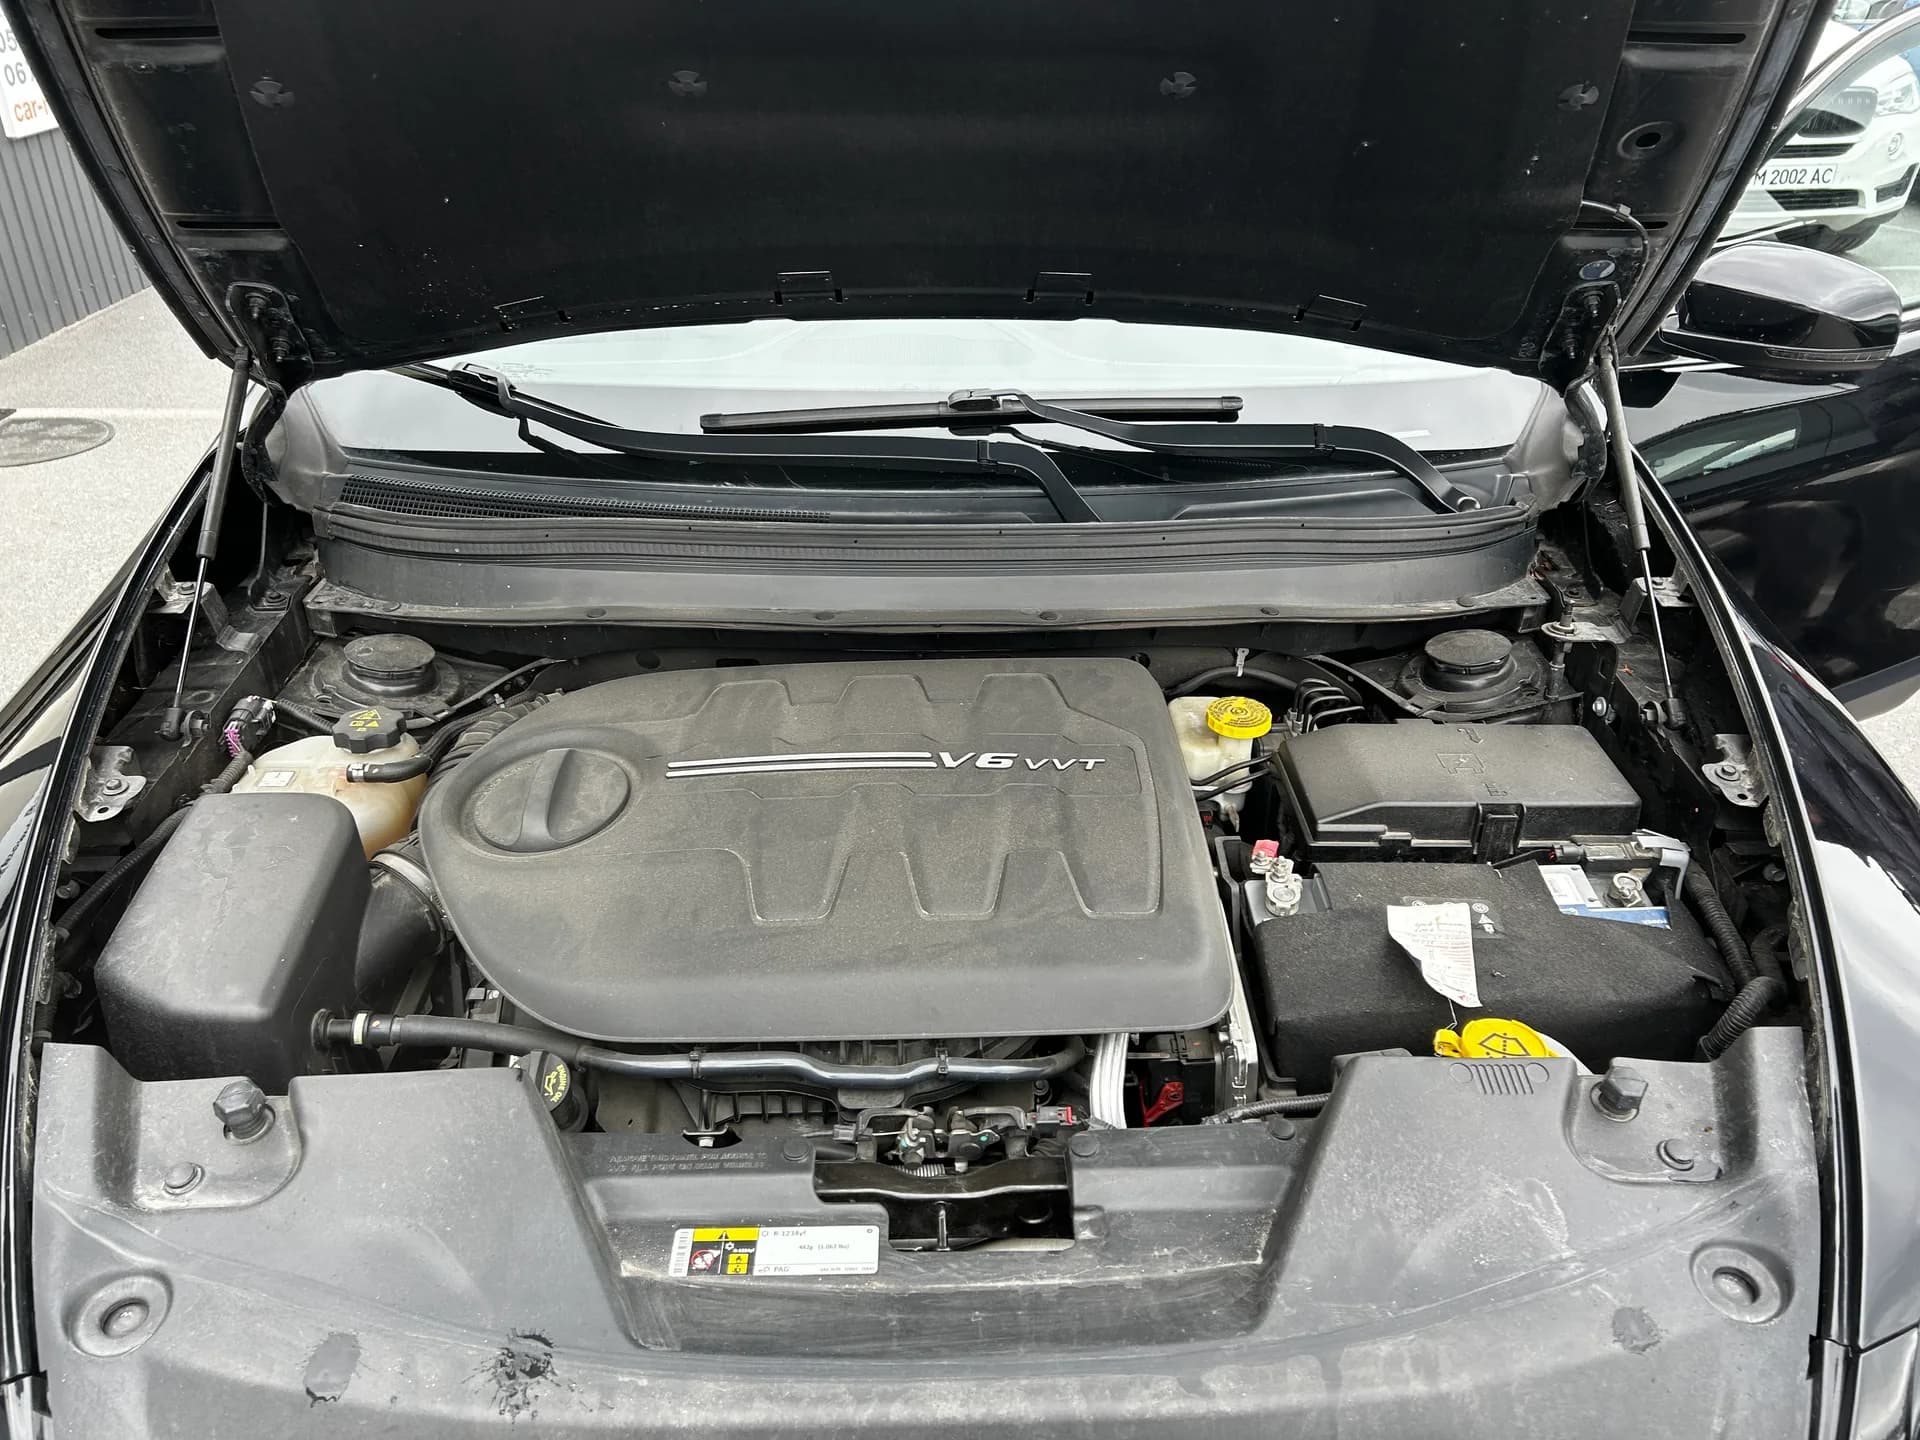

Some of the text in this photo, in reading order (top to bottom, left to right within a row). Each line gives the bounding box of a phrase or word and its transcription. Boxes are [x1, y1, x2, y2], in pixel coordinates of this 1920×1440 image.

[4, 62, 27, 87] 06
[1769, 168, 1807, 185] 2002
[1810, 168, 1833, 185] AC
[938, 751, 1106, 770] V6 VVT
[550, 1064, 567, 1102] ENGINE OIL
